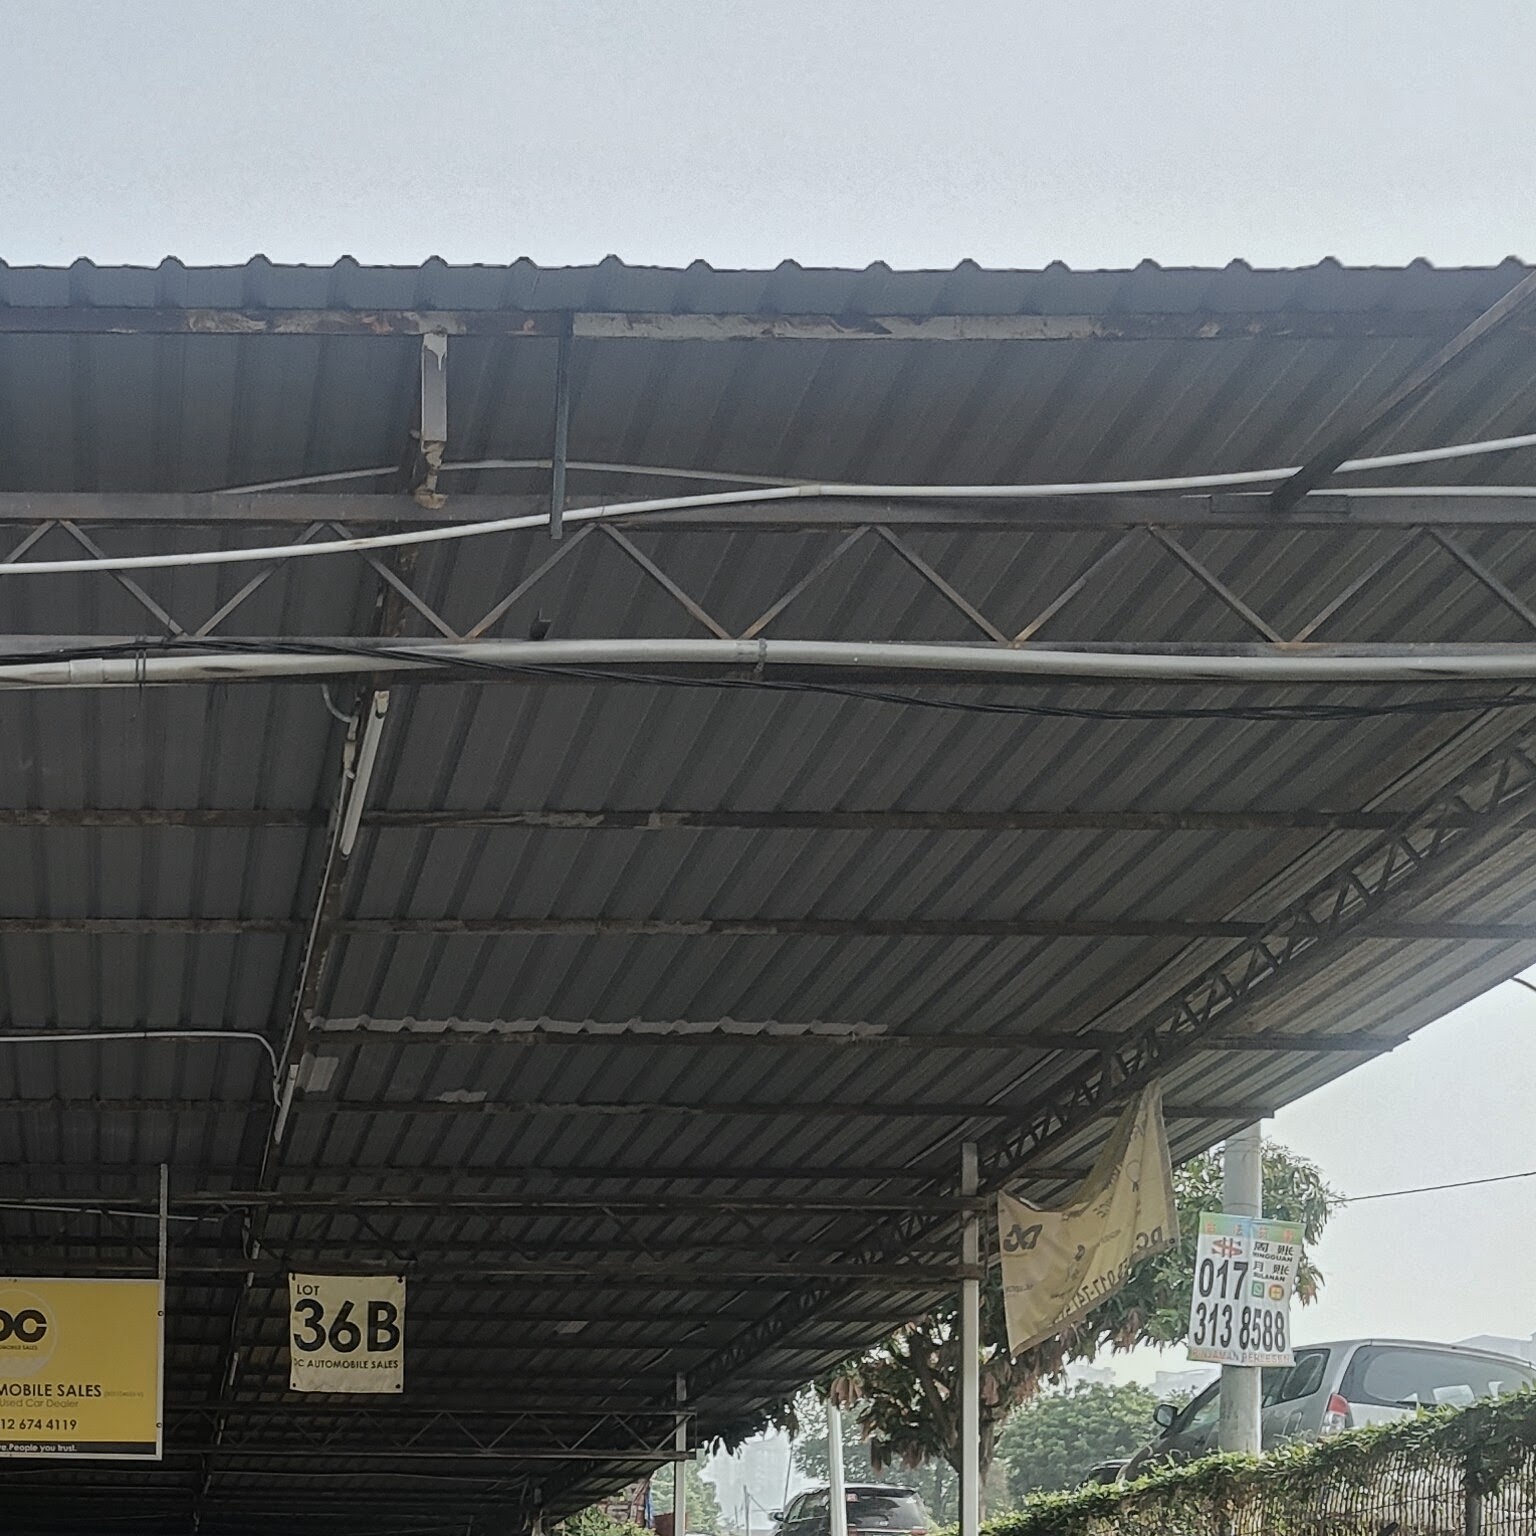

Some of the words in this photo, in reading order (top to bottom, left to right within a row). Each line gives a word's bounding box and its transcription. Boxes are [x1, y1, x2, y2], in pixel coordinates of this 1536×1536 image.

[1199, 1258, 1249, 1300] 017
[297, 1284, 320, 1296] LOT
[293, 1298, 401, 1353] 36B
[1194, 1302, 1232, 1348] 313
[1239, 1306, 1286, 1352] 8588
[307, 1359, 369, 1369] AUTOMOBILE
[371, 1360, 399, 1369] SALES
[56, 1384, 102, 1397] SALES
[0, 1398, 23, 1408] Used
[26, 1399, 43, 1408] Car
[46, 1399, 79, 1408] Dealer
[19, 1419, 42, 1430] 674
[46, 1419, 77, 1431] 4119
[40, 1445, 56, 1453] you
